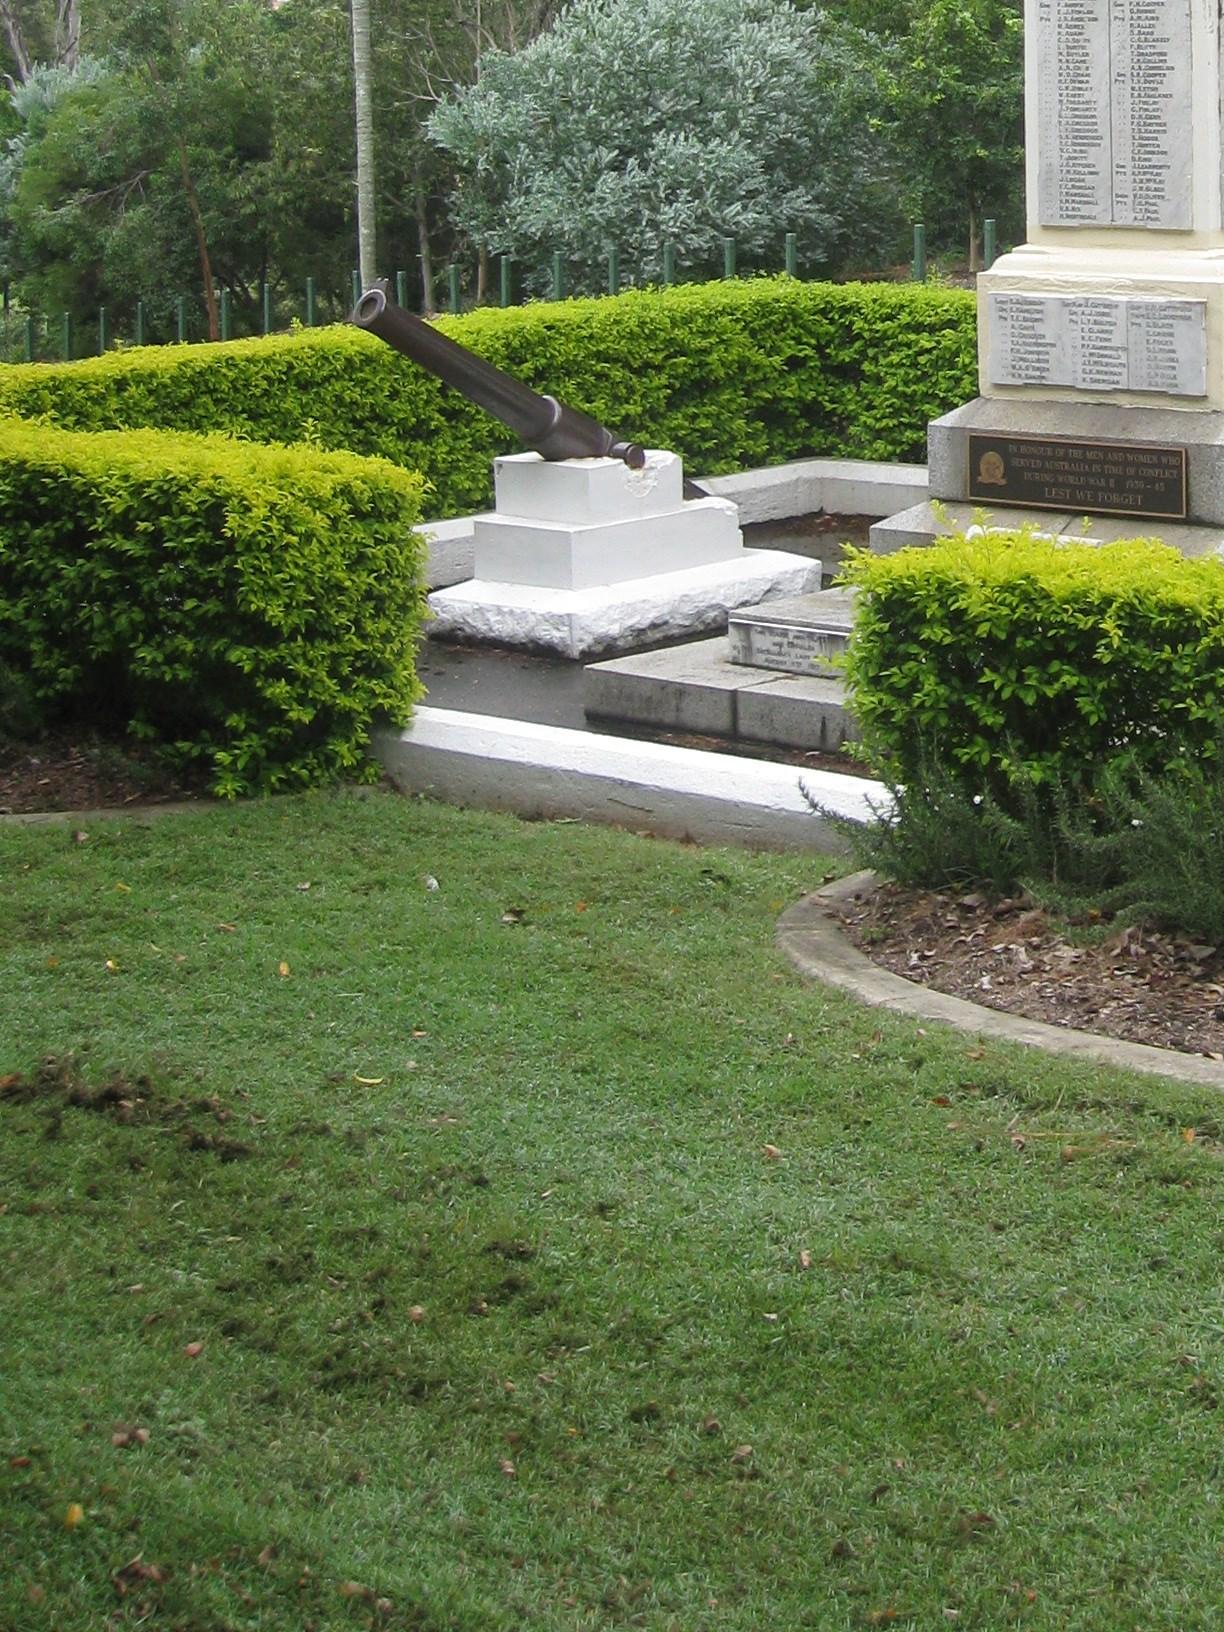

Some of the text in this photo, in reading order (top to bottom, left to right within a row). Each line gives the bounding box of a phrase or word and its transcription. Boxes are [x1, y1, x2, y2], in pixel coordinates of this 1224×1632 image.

[1019, 446, 1053, 456] HONOUR
[1056, 448, 1067, 457] OF
[1068, 449, 1085, 458] THE
[1087, 450, 1105, 460] MEN
[1109, 452, 1126, 462] AND
[1127, 453, 1158, 464] WOMEN
[1161, 455, 1181, 466] WHO
[1011, 458, 1179, 479] SERVED AUSTRALIA IN TIME OF CONFLICT
[1024, 471, 1055, 482] DURING
[1057, 474, 1086, 486] WORLD
[1089, 477, 1106, 487] WAR
[1045, 487, 1144, 506] LEST WE FORGET
